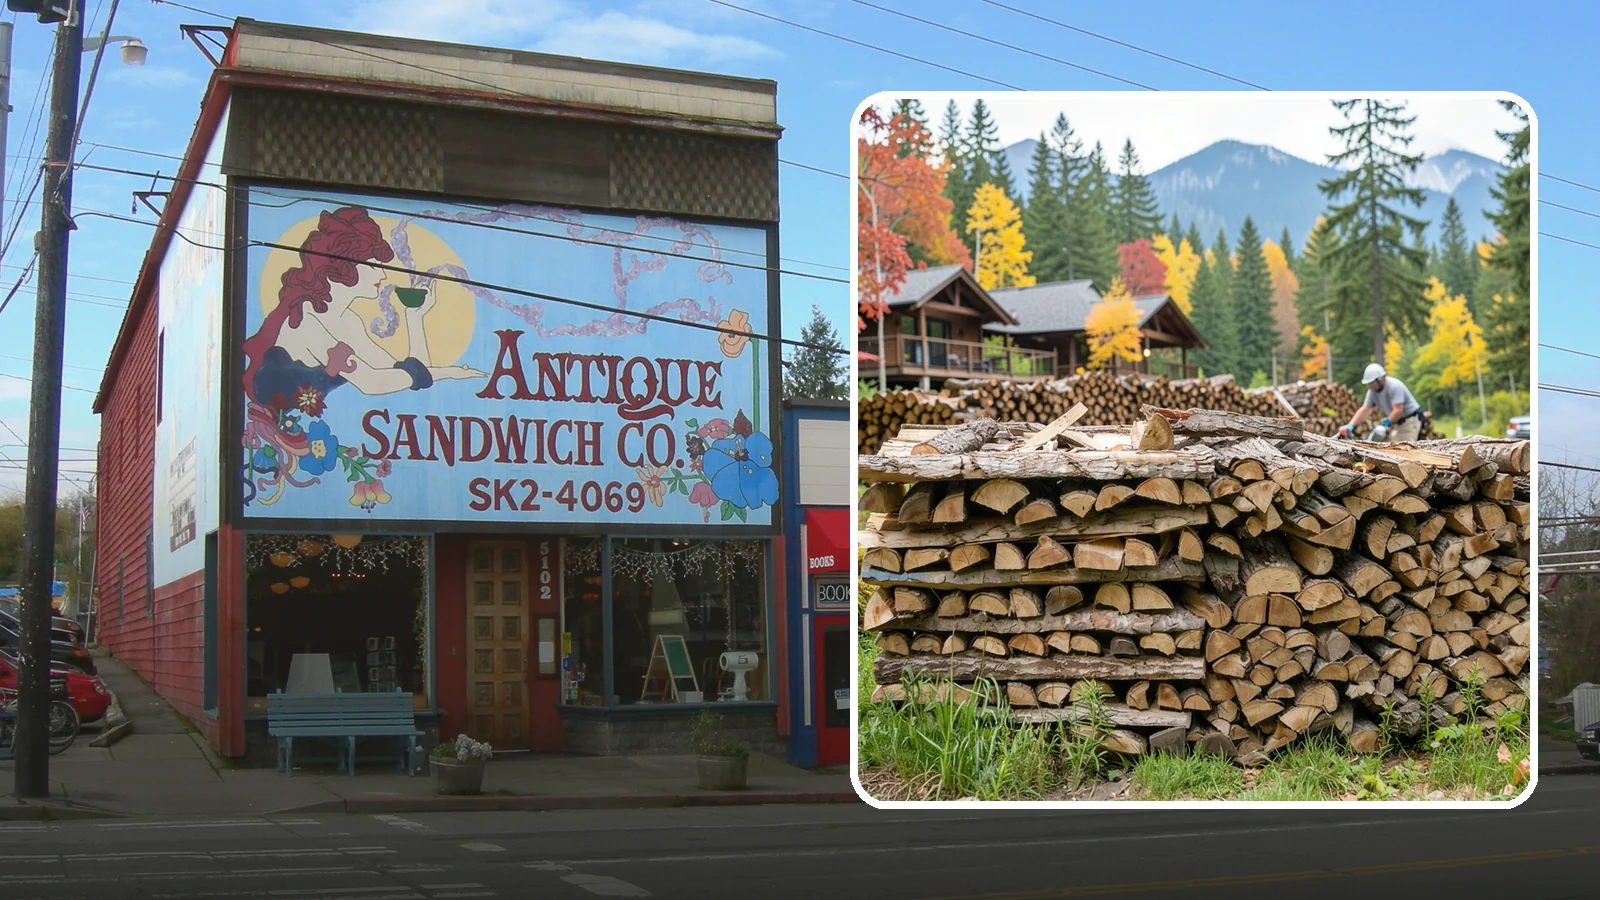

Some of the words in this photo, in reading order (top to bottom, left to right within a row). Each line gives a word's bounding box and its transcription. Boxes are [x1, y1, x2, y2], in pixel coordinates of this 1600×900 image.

[476, 330, 723, 420] ANTIQUE
[362, 409, 604, 466] SANDWICH
[617, 422, 684, 468] CO.
[469, 478, 645, 513] SK2-4069
[540, 542, 551, 600] 5102
[809, 555, 834, 568] BOOKS
